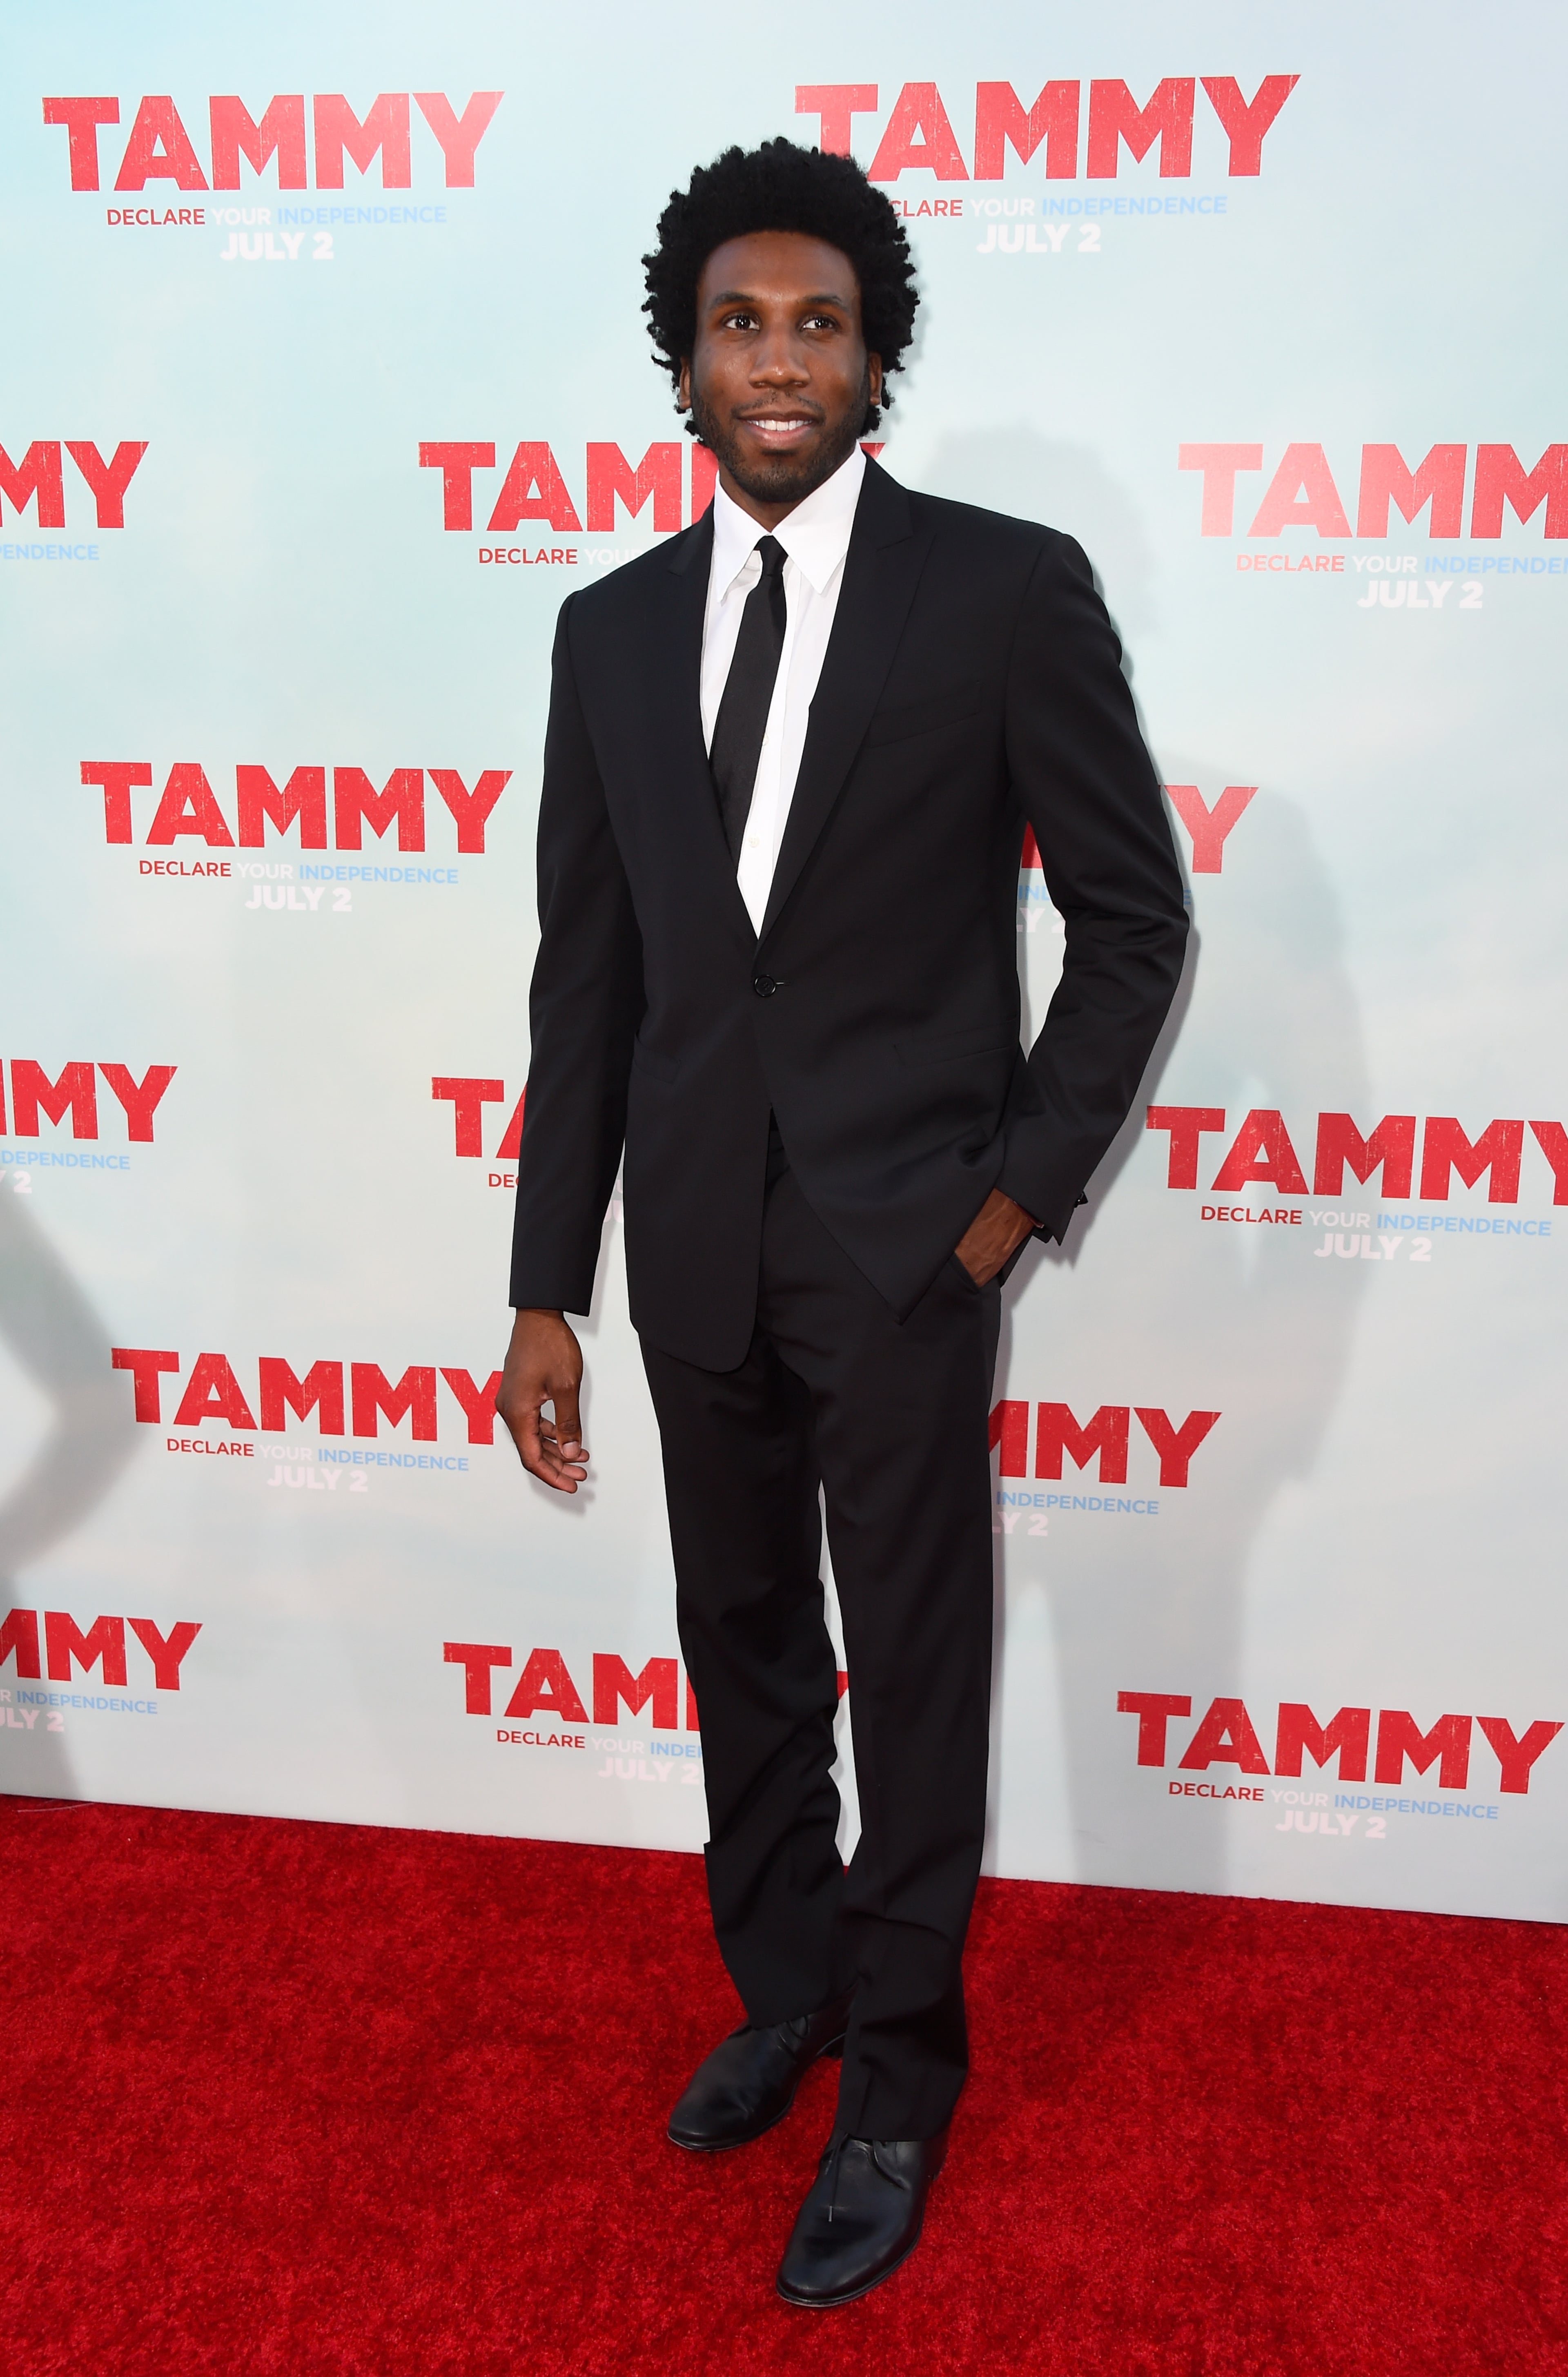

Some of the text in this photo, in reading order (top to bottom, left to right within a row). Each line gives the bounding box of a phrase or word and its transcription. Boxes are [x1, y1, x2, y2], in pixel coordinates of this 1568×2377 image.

[42, 91, 505, 191] TAMMY
[795, 75, 1301, 181] TAMMY
[107, 206, 447, 225] DECLARE YOUR INDEPENDENCE
[889, 196, 1227, 217] CLARE YOUR INDEPENDENCE
[220, 232, 334, 261] JULY 2
[976, 223, 1101, 253] JULY 2
[418, 442, 885, 532] TAM
[0, 544, 99, 560] ENDENCE
[479, 549, 577, 564] DECLARE
[1236, 554, 1345, 572] DECLARE
[1352, 556, 1417, 573] YOUR
[1356, 580, 1483, 609] JULY 2
[80, 762, 513, 854] TAMMY
[139, 860, 459, 884] DECLARE YOUR INDEPENDENCE
[245, 885, 352, 912] JULY 2
[0, 1059, 178, 1142] MY
[13, 1171, 32, 1193] 2
[1200, 1206, 1551, 1236] DECLARE YOUR INDEPENDENCE
[1314, 1233, 1431, 1262] JULY 2
[111, 1347, 503, 1445] TAMMY
[167, 1438, 469, 1470] DECLARE YOUR INDEPENDENCE
[267, 1464, 368, 1492] JULY 2
[996, 1491, 1159, 1514] INDEPENDENCE
[1027, 1513, 1049, 1536] 2
[443, 1641, 849, 1731] TAM
[17, 1690, 158, 1714] INDEPENDENCE
[47, 1711, 65, 1732] 2
[497, 1729, 585, 1748] DECLARE
[590, 1736, 644, 1755] YOUR
[1117, 1690, 1565, 1794] TAMMY
[598, 1755, 700, 1785] JULY 2
[1168, 1781, 1499, 1820] DECLARE YOUR INDEPENDENCE
[1276, 1810, 1386, 1839] JULY 2
